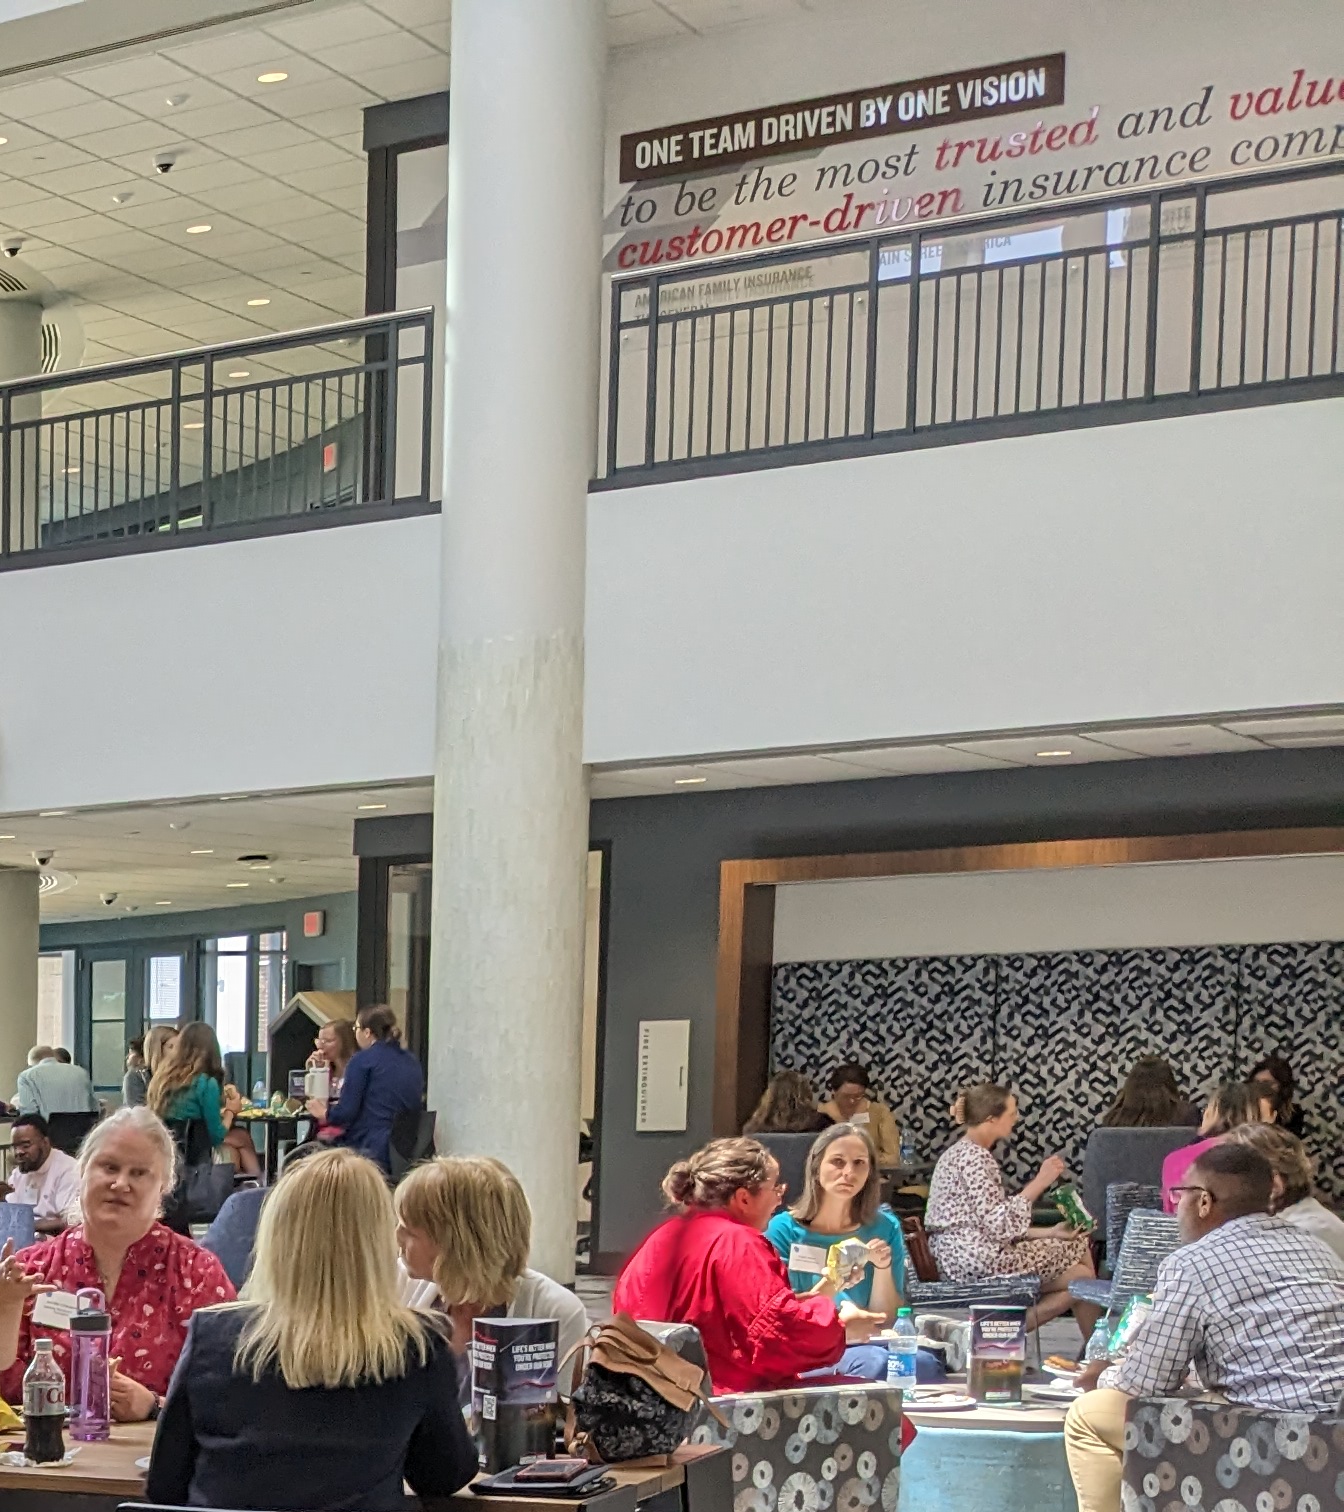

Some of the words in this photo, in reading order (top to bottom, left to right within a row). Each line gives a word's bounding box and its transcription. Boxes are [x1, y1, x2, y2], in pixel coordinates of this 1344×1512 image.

[619, 194, 657, 227] to
[674, 179, 717, 217] be
[734, 166, 798, 206] the
[814, 143, 920, 192] most
[934, 105, 1101, 171] trusted
[1116, 84, 1216, 139] and
[635, 133, 684, 170] ONE
[689, 120, 756, 158] TEAM
[761, 102, 854, 145] DRIVEN
[860, 94, 892, 128] BY
[898, 84, 951, 121] ONE
[956, 67, 1046, 111] VISION
[617, 187, 963, 270] customer-driven
[982, 145, 1212, 208] insurance
[634, 285, 695, 308] AMRICAN
[697, 278, 741, 298] FAMILY
[743, 265, 814, 289] INSURANCE
